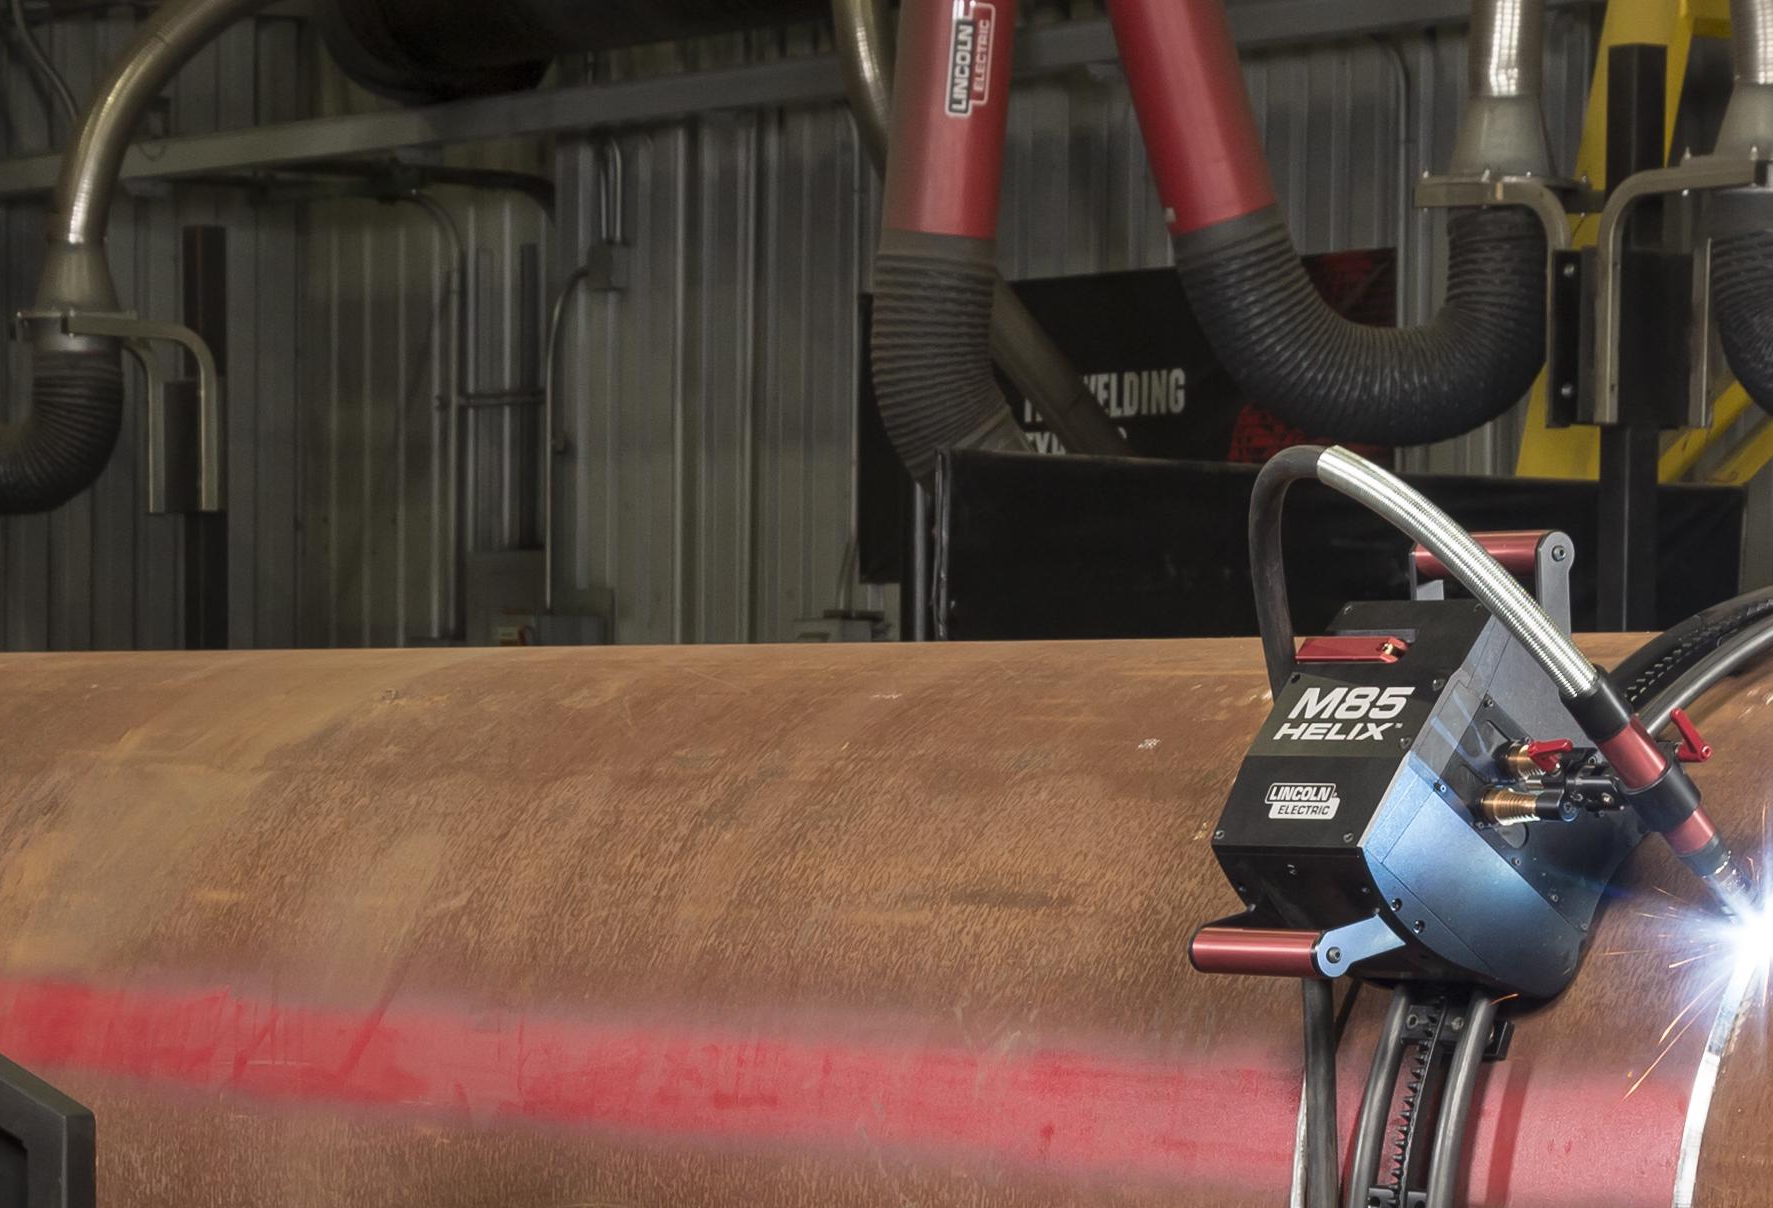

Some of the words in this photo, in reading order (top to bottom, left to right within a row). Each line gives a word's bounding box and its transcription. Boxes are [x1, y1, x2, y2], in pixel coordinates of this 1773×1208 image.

[951, 24, 974, 111] LINCOLN
[973, 19, 990, 93] ELECTRIC
[1288, 686, 1416, 719] M85
[1273, 722, 1394, 741] HELIX
[1269, 786, 1332, 801] LINCOLN
[1278, 804, 1331, 815] ELECTRIC
